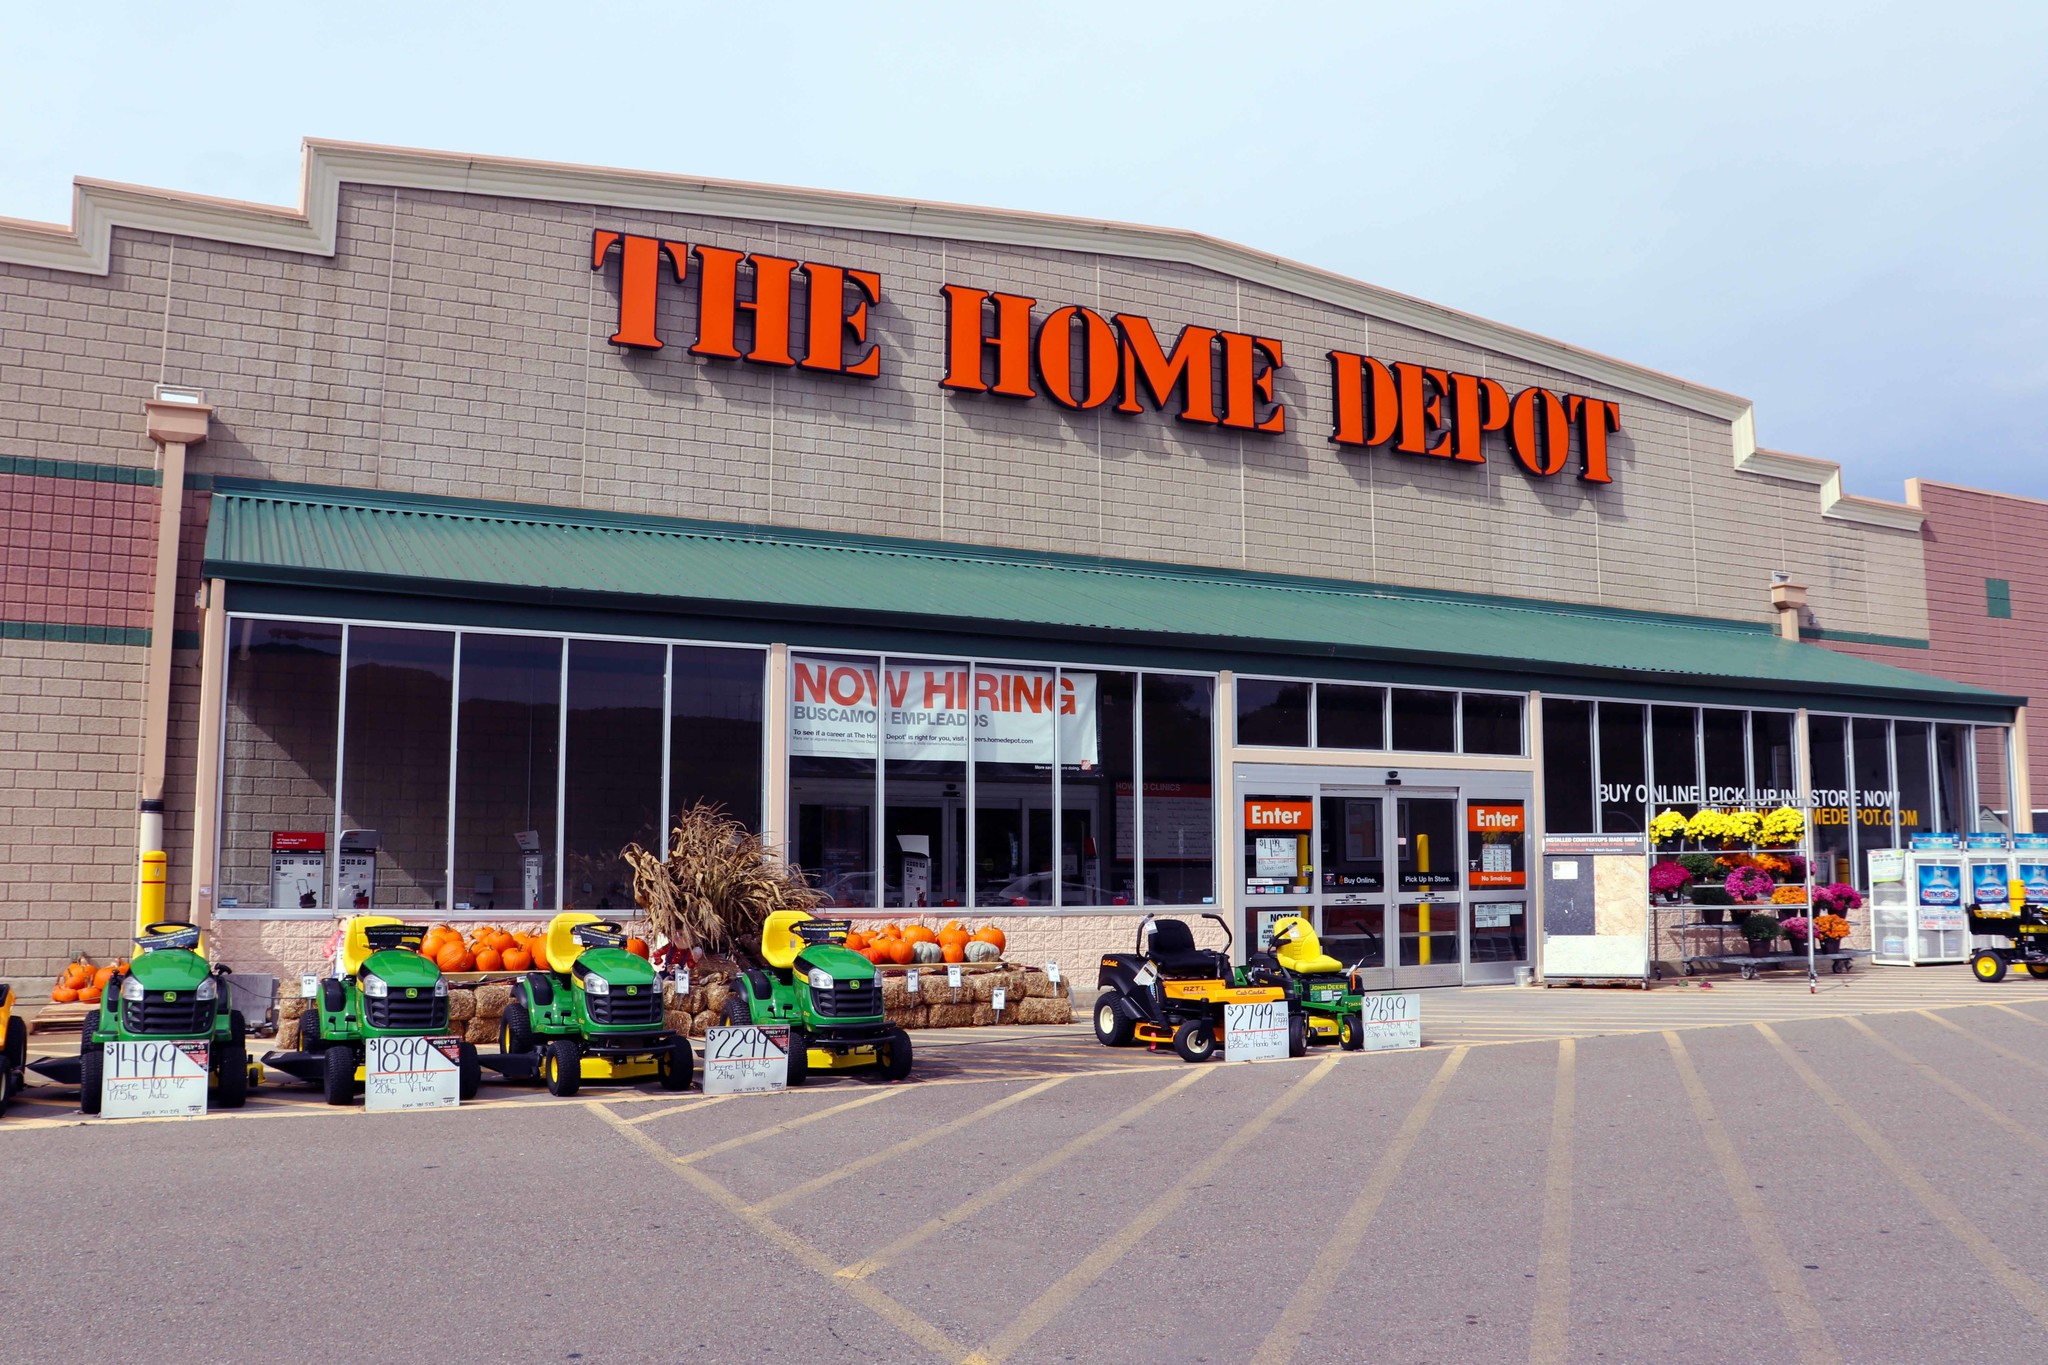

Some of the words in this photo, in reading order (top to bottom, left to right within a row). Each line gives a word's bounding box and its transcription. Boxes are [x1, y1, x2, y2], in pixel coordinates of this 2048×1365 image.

[591, 228, 881, 380] THE
[939, 283, 1286, 436] HOME
[1326, 350, 1620, 484] DEPOT
[794, 663, 910, 708] NOW
[923, 671, 1076, 716] HIRING
[794, 706, 886, 723] BUSCAMO
[965, 736, 1033, 744] eers.homedepot.com
[1600, 784, 1631, 802] BUY
[1709, 786, 1746, 804] PICK
[1756, 789, 1777, 806] UP
[1811, 789, 1861, 807] STORE
[1865, 790, 1900, 807] NOW
[1251, 805, 1301, 824] Enter
[1477, 809, 1518, 827] Enter
[1419, 876, 1427, 884] Up
[1227, 1003, 1273, 1031] $2799
[1365, 996, 1406, 1023] $2699
[709, 1028, 769, 1059] $2299
[106, 1042, 177, 1078] $1499
[370, 1038, 429, 1073] $1899
[709, 1060, 733, 1071] Deere
[106, 1078, 139, 1091] Deere
[369, 1073, 397, 1084] Deere
[148, 1090, 169, 1100] Auto
[375, 1082, 397, 1095] 20hp
